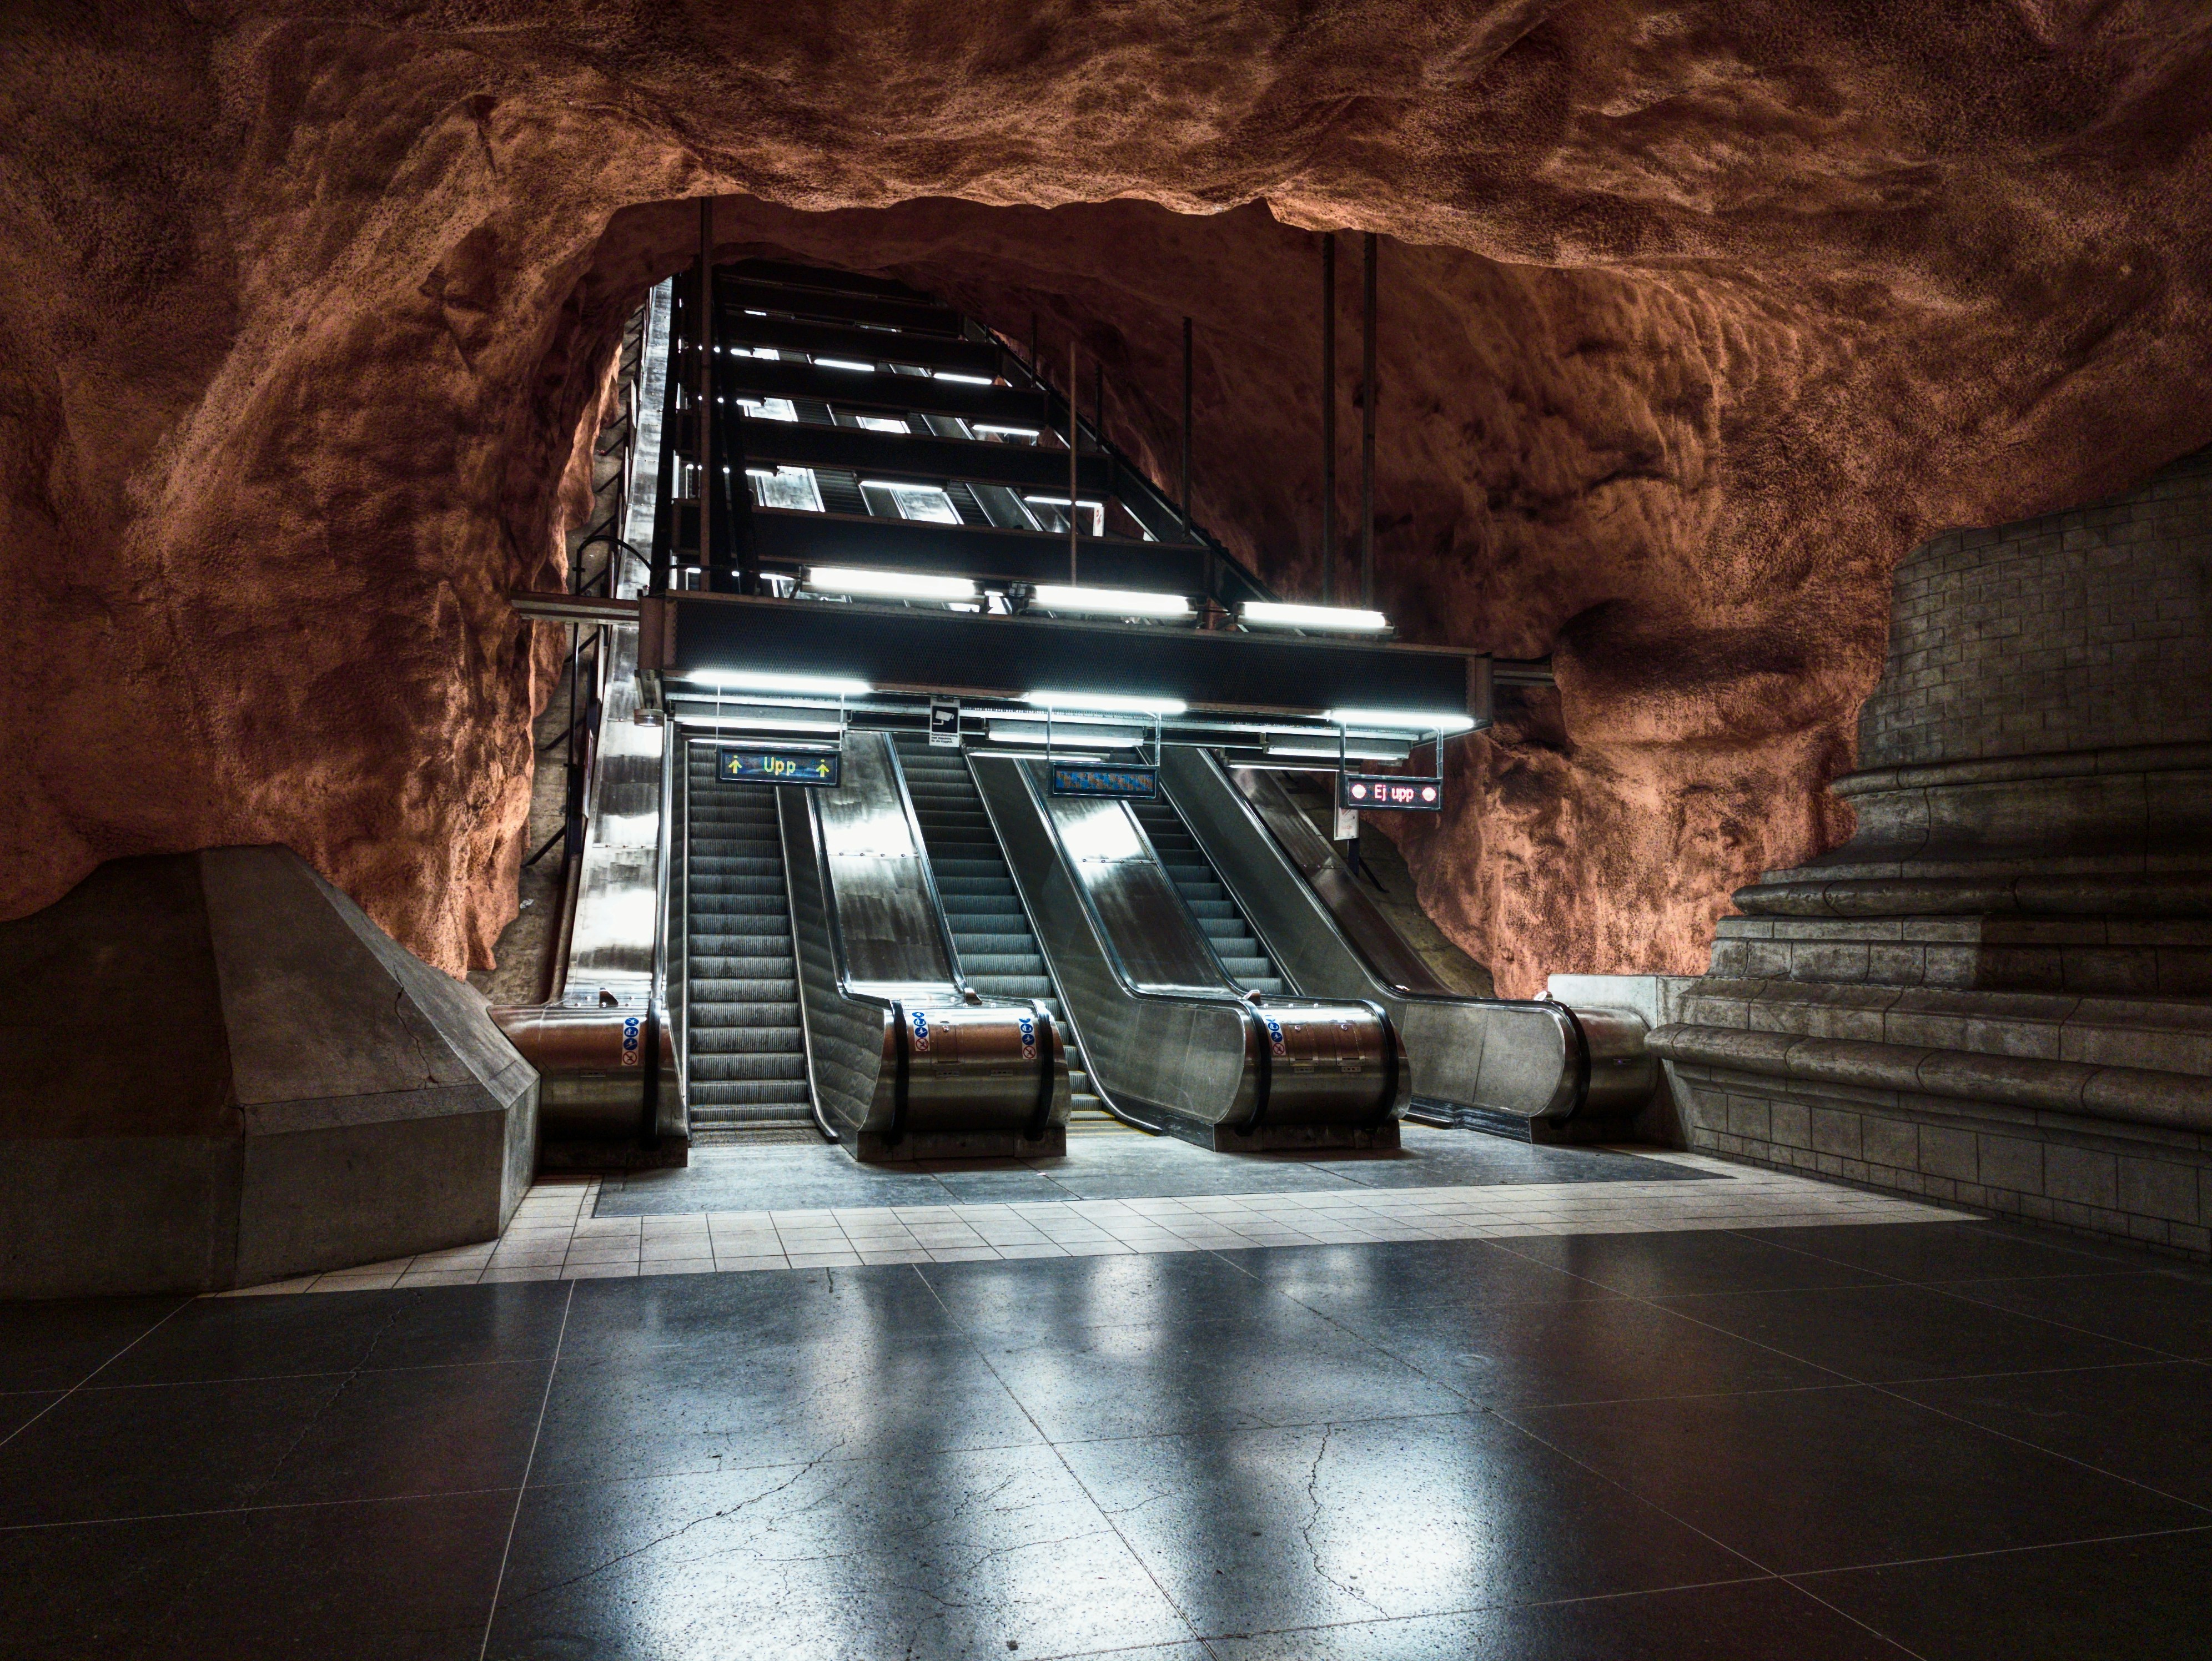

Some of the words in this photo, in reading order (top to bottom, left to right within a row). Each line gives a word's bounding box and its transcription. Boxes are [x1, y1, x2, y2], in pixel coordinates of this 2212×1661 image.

[764, 757, 796, 776] Upp
[1374, 784, 1386, 801] Ej
[1391, 787, 1414, 802] upp
